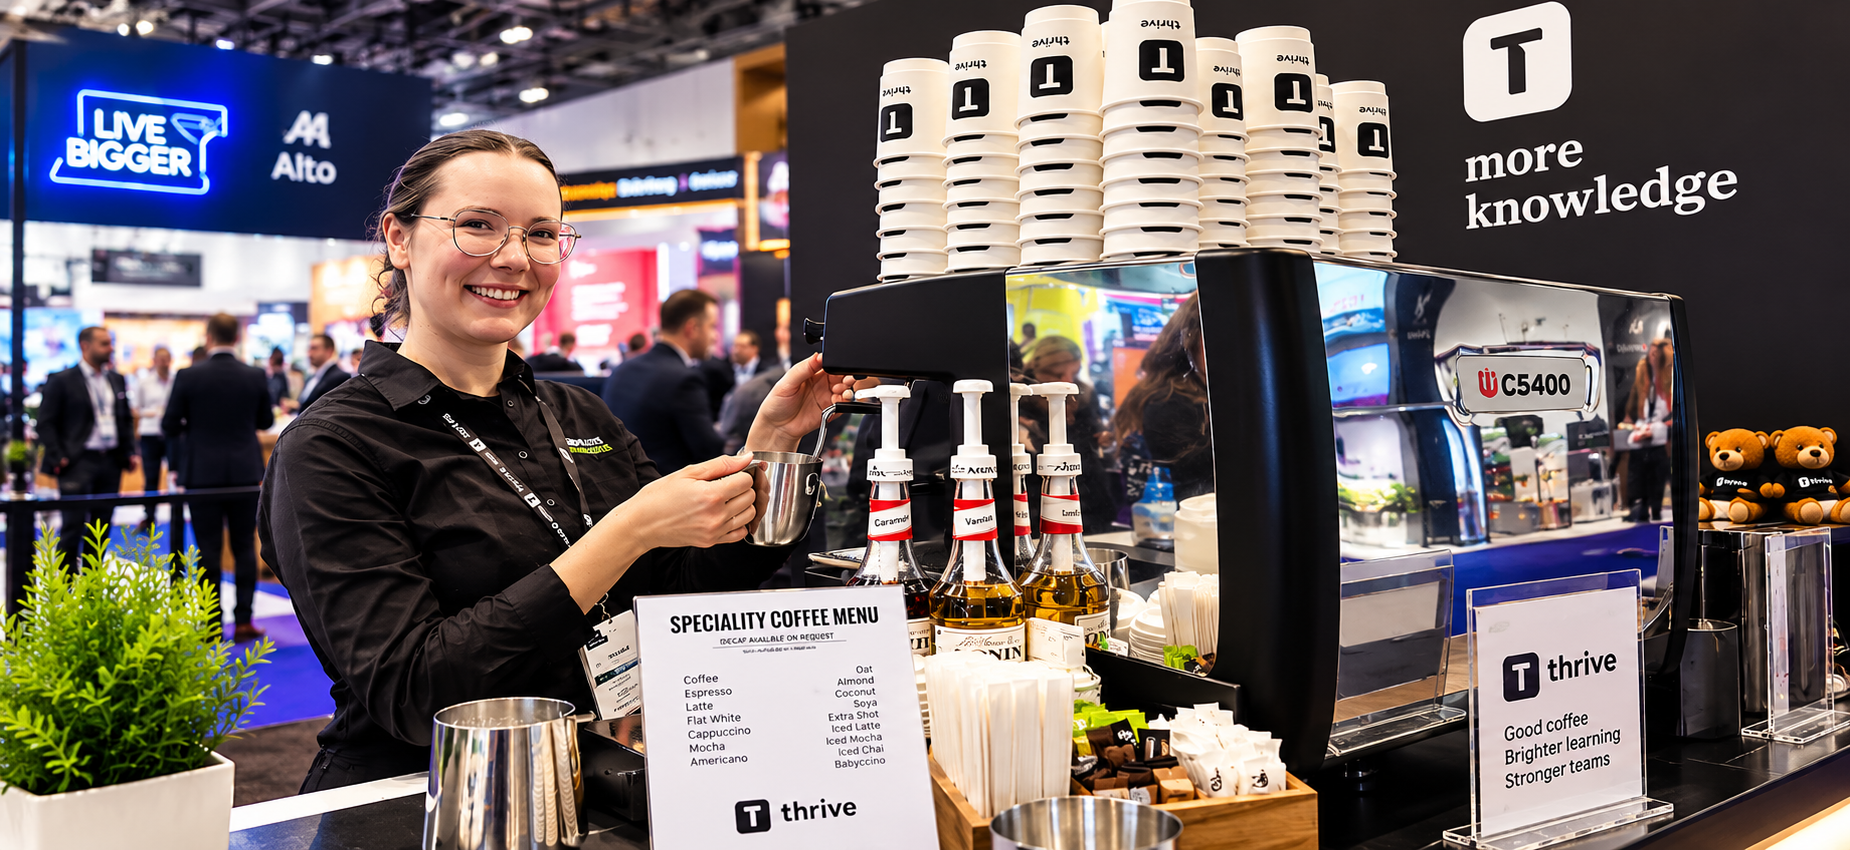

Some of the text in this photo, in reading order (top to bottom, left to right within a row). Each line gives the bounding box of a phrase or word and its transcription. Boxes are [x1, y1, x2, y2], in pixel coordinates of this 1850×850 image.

[1140, 19, 1181, 30] thrive
[1031, 35, 1070, 48] thrive
[954, 59, 987, 71] thrive
[1276, 54, 1310, 66] thrive
[1213, 65, 1241, 78] thrive
[882, 85, 912, 97] thrive
[1358, 106, 1387, 117] thrive
[91, 108, 167, 146] LIVE
[65, 137, 193, 177] BIGGER
[1465, 140, 1584, 183] more
[271, 151, 337, 184] Alto
[1465, 165, 1738, 230] knowledge
[1501, 373, 1571, 397] C5400
[670, 606, 879, 634] SPECIALITY COFFEE MENU
[855, 665, 873, 674] Oat
[1547, 650, 1617, 682] thrive
[683, 673, 719, 685] Coffee
[837, 675, 875, 686] Almond
[684, 688, 733, 700] Espresso
[834, 687, 876, 699] Coconut
[685, 702, 714, 712] Latte
[853, 699, 878, 709] Soya
[687, 713, 742, 726] Flat White
[828, 710, 879, 722] Extra Shot
[687, 726, 751, 741] Cappuccino
[831, 722, 881, 733] Iced Latte
[1504, 712, 1589, 742] Good coffee
[825, 733, 883, 746] Iced Mocha
[689, 741, 726, 753] Mocha
[838, 744, 885, 757] Iced Chai
[1504, 728, 1621, 765] Brighter learning
[690, 755, 748, 767] Americano
[834, 756, 886, 769] Babyccino
[1505, 754, 1611, 789] Stronger teams
[780, 798, 857, 822] thrive
